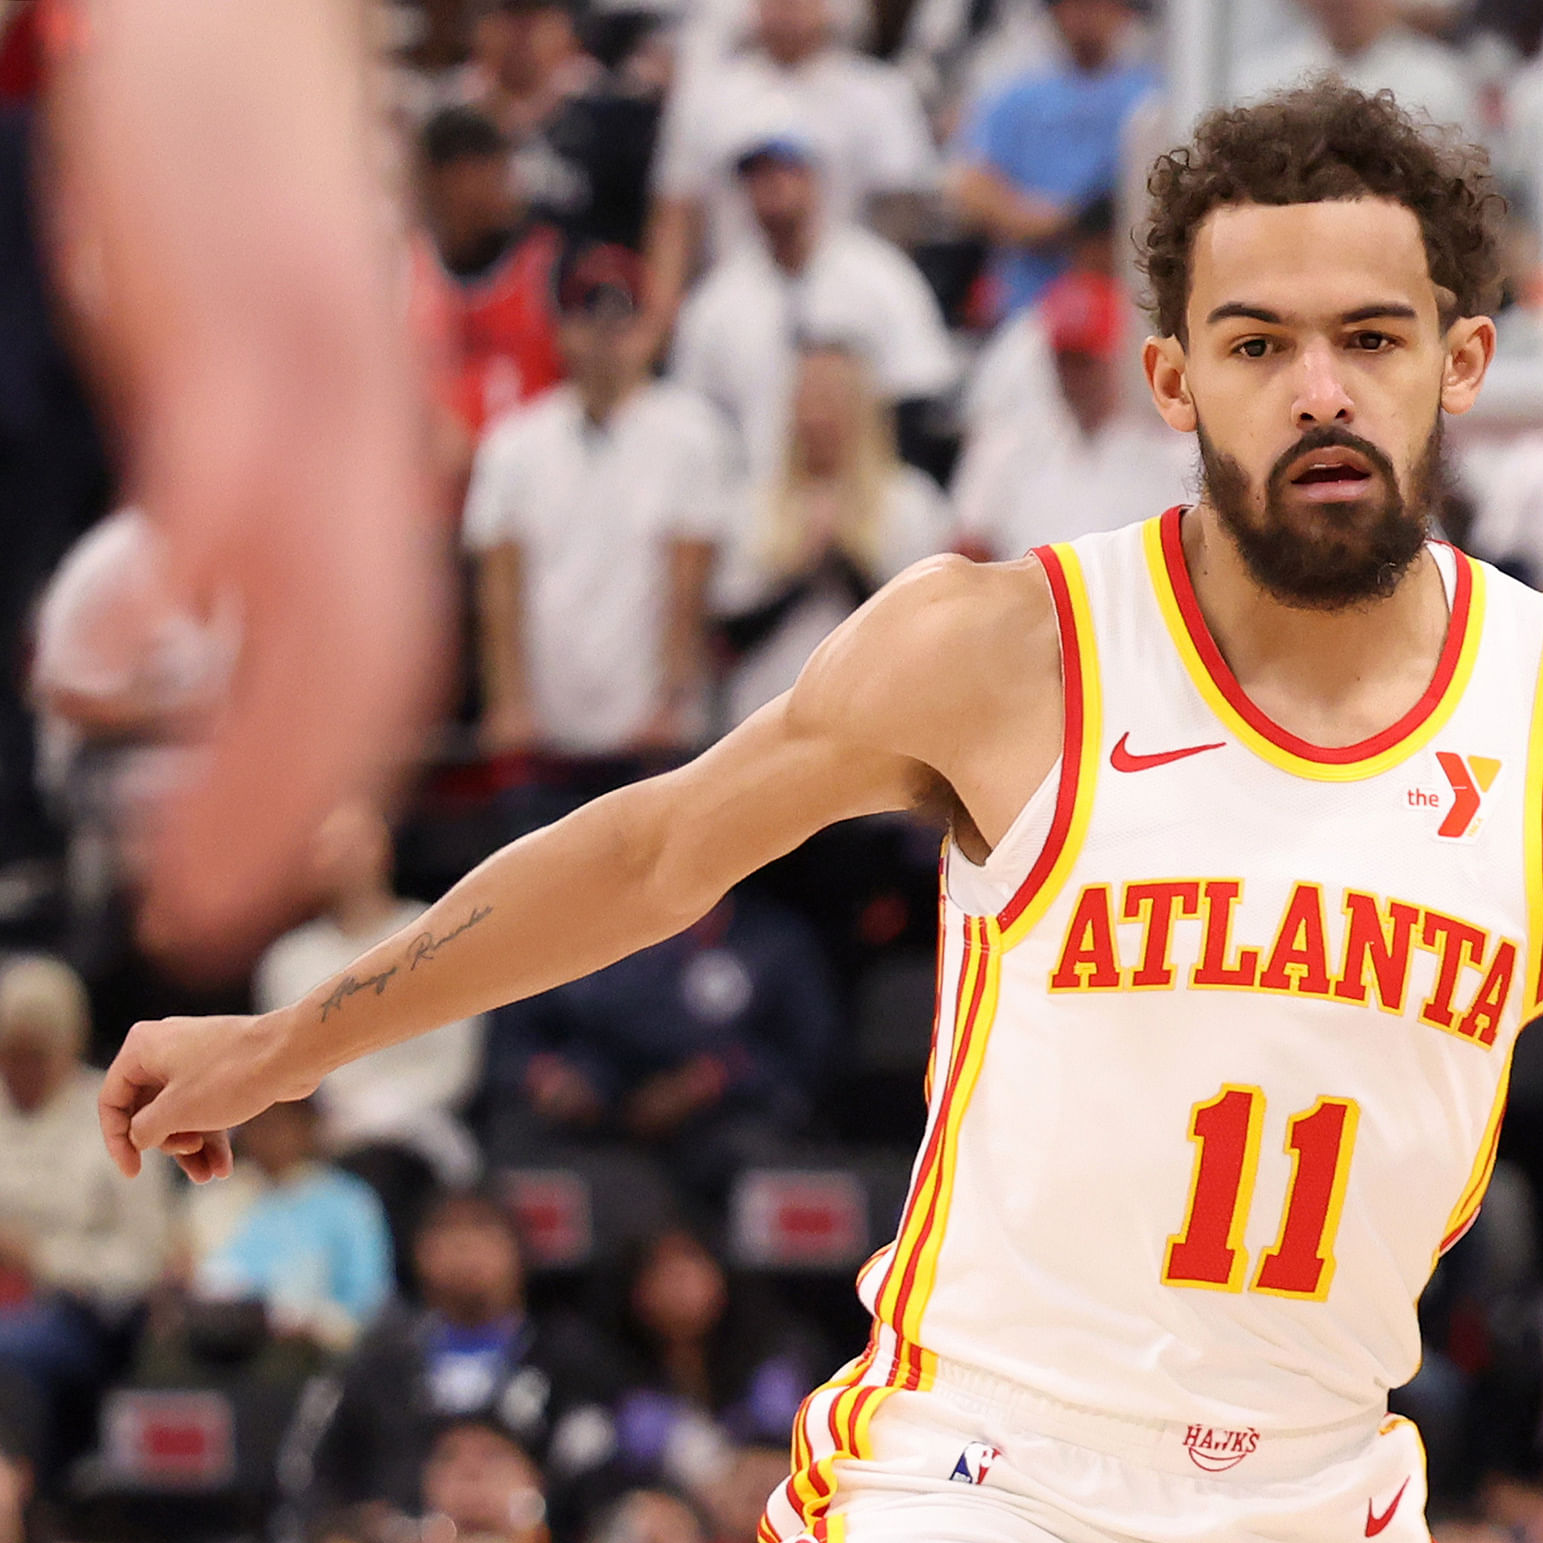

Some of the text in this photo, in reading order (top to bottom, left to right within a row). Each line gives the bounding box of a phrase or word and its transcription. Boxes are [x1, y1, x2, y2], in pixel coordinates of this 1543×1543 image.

[1407, 787, 1439, 807] the
[1047, 876, 1521, 1052] ATLANTA
[1160, 1082, 1362, 1304] 11
[1182, 1422, 1261, 1454] HAWKS
